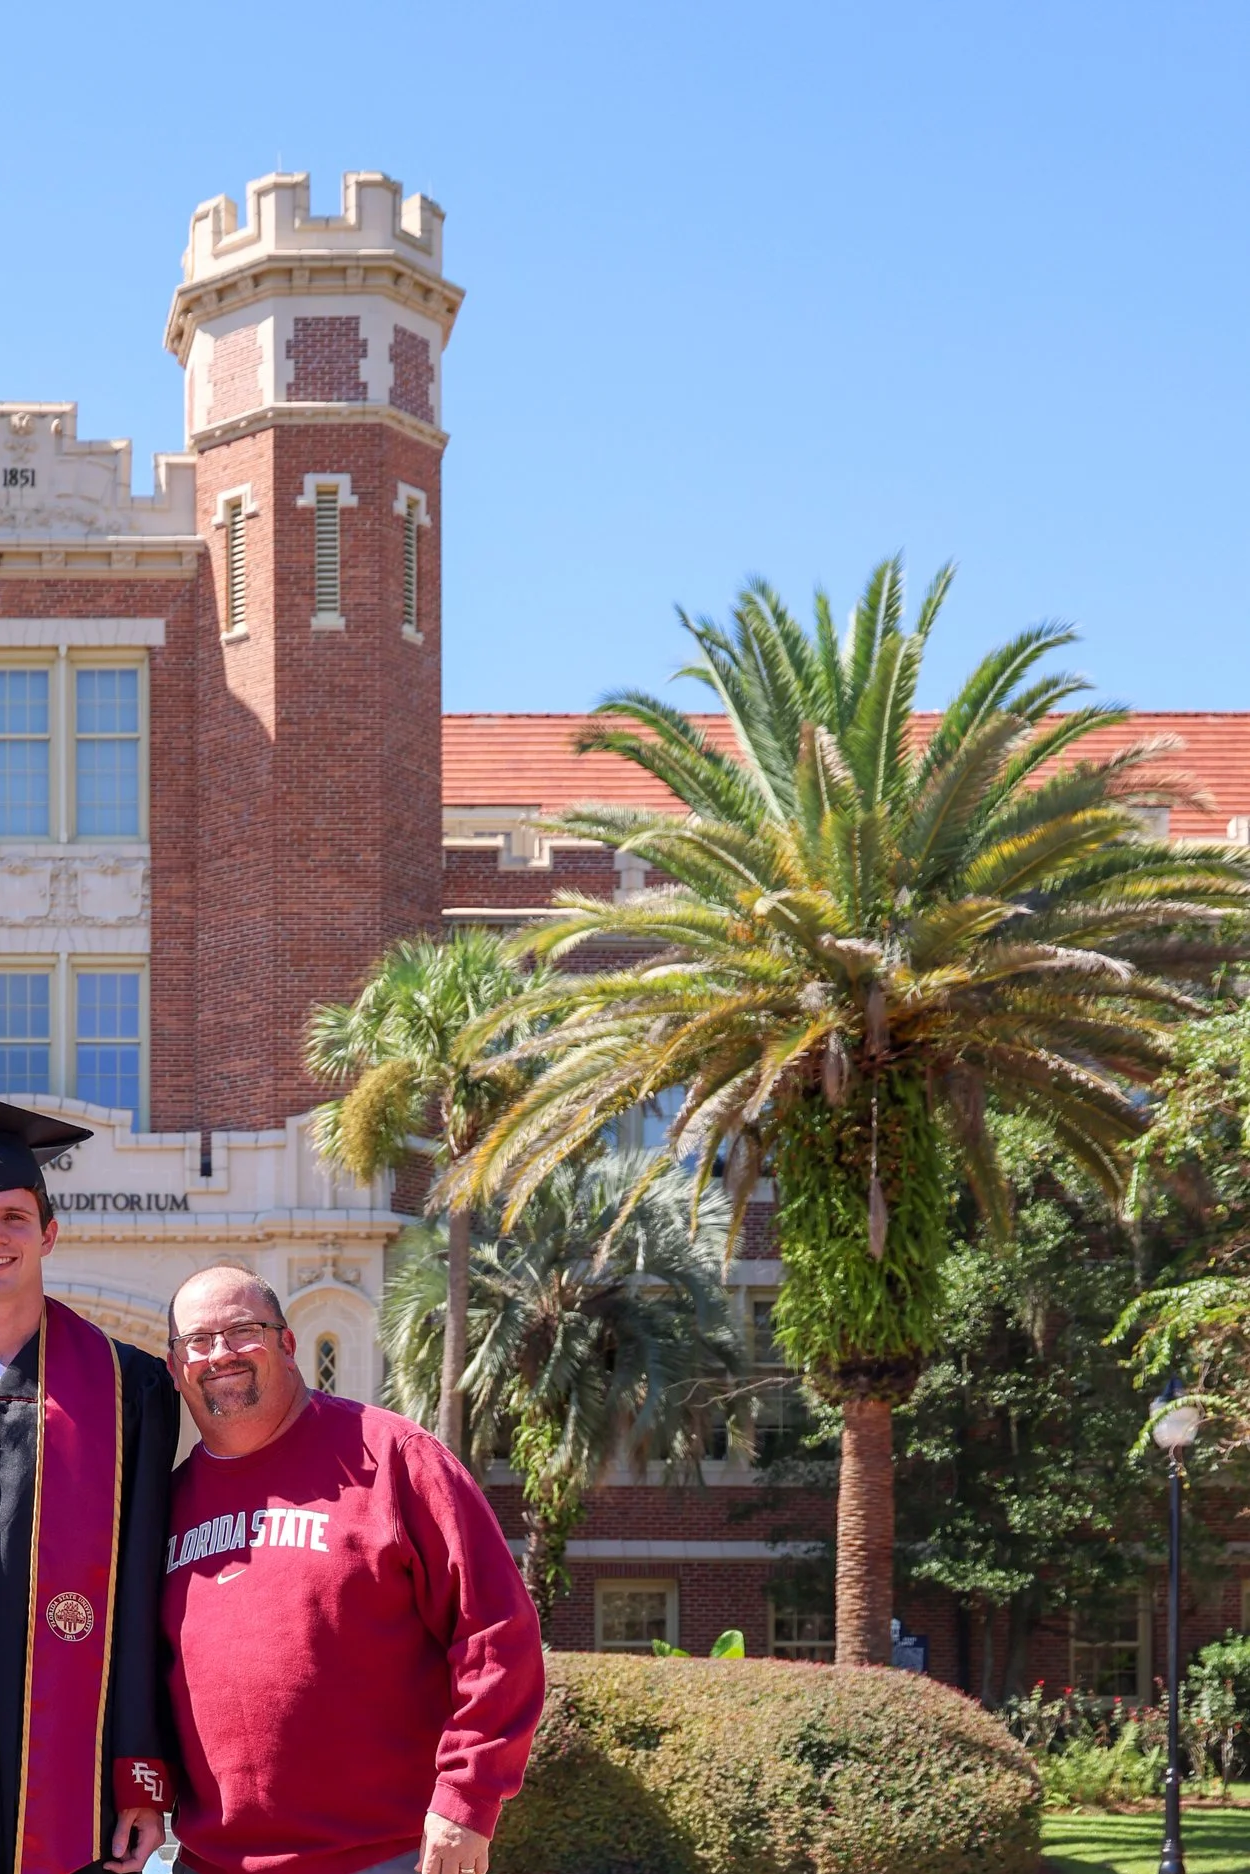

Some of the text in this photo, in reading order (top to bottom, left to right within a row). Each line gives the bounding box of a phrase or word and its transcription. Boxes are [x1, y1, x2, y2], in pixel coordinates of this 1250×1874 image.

[2, 467, 36, 487] 1851
[49, 1192, 190, 1212] AUDITORIUM
[165, 1508, 330, 1575] LORIDA STATE
[131, 1761, 164, 1802] FSU
